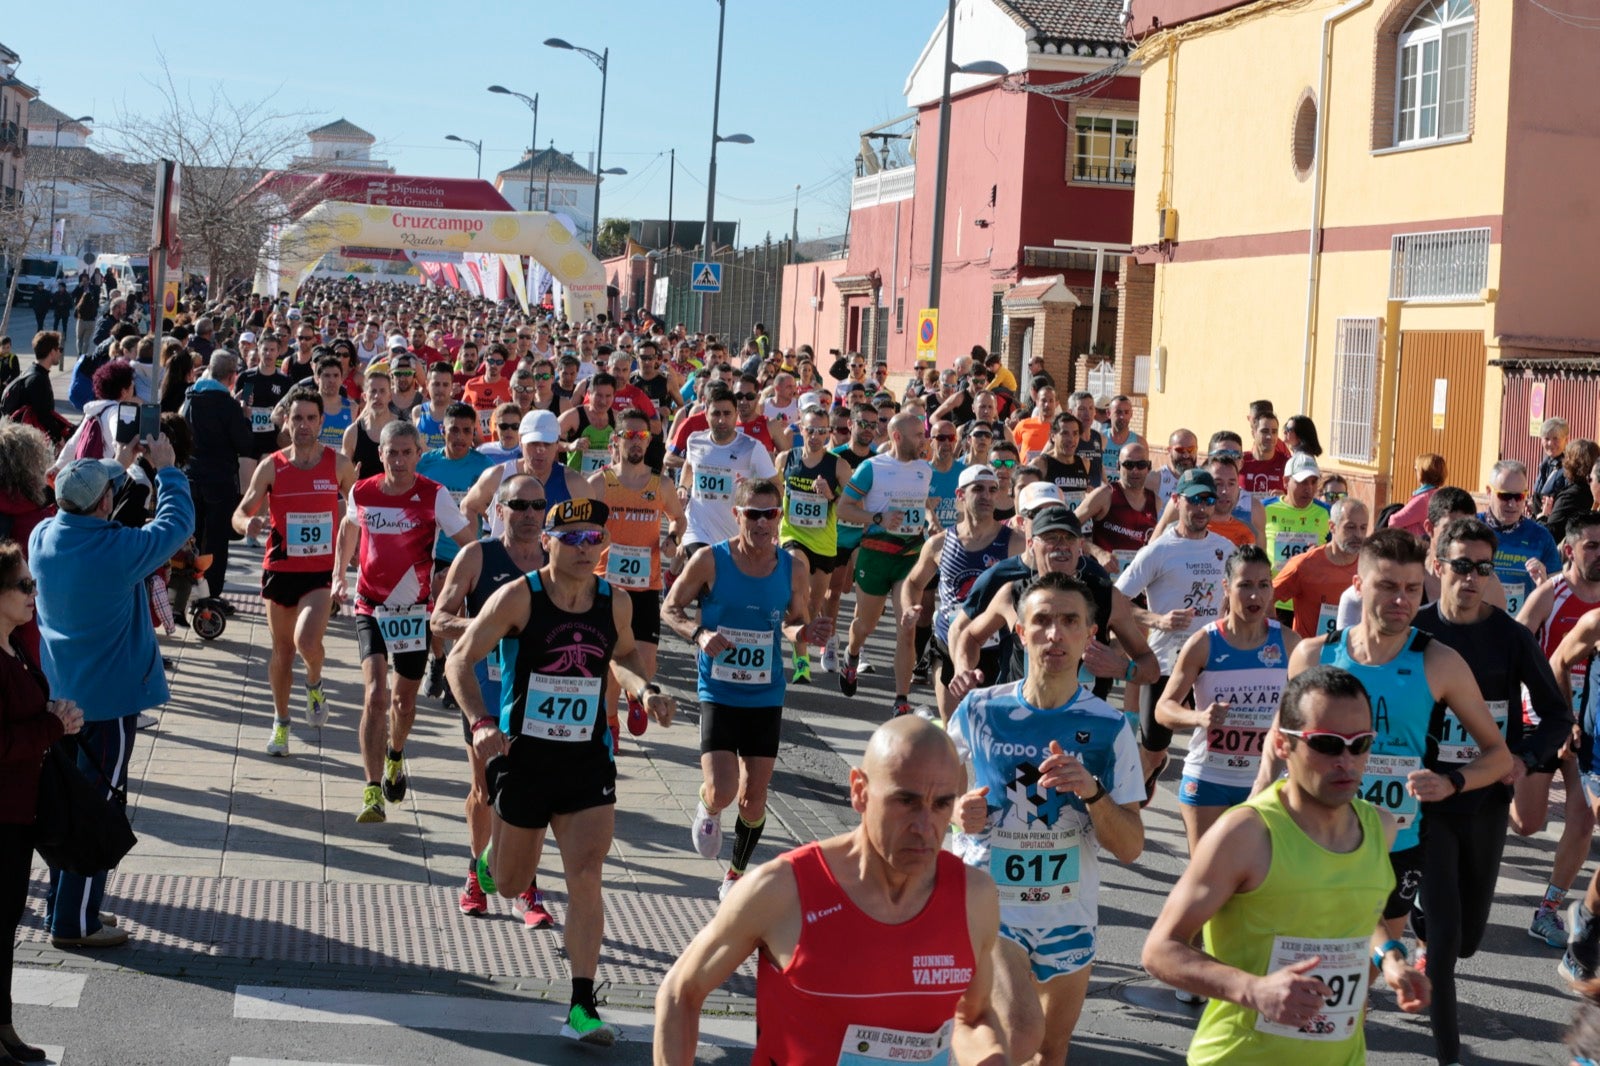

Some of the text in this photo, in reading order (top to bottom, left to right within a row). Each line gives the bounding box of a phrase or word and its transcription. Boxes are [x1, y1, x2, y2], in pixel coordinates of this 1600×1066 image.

[391, 183, 445, 196] Diputación
[391, 196, 444, 208] de Granada
[392, 212, 483, 233] Cruzcampo
[400, 233, 445, 247] Radler
[699, 475, 725, 491] 301
[795, 502, 821, 517] 658
[300, 526, 321, 542] 59
[619, 558, 641, 574] 20
[381, 618, 423, 638] 1007
[723, 647, 765, 667] 208
[538, 696, 588, 721] 470
[1042, 747, 1084, 764] SMA
[1370, 757, 1416, 767] PREMIO DE FONDO
[997, 829, 1076, 840] XXXIII GRAN PREMIO DE FONDO
[1020, 841, 1055, 849] DIPUTACIÓN
[1005, 854, 1068, 882] 617
[912, 955, 955, 967] RUNNING
[912, 968, 973, 985] VAMPIROS
[1311, 973, 1361, 1007] 97
[856, 1029, 880, 1042] XXXIII
[880, 1033, 903, 1045] GRAN
